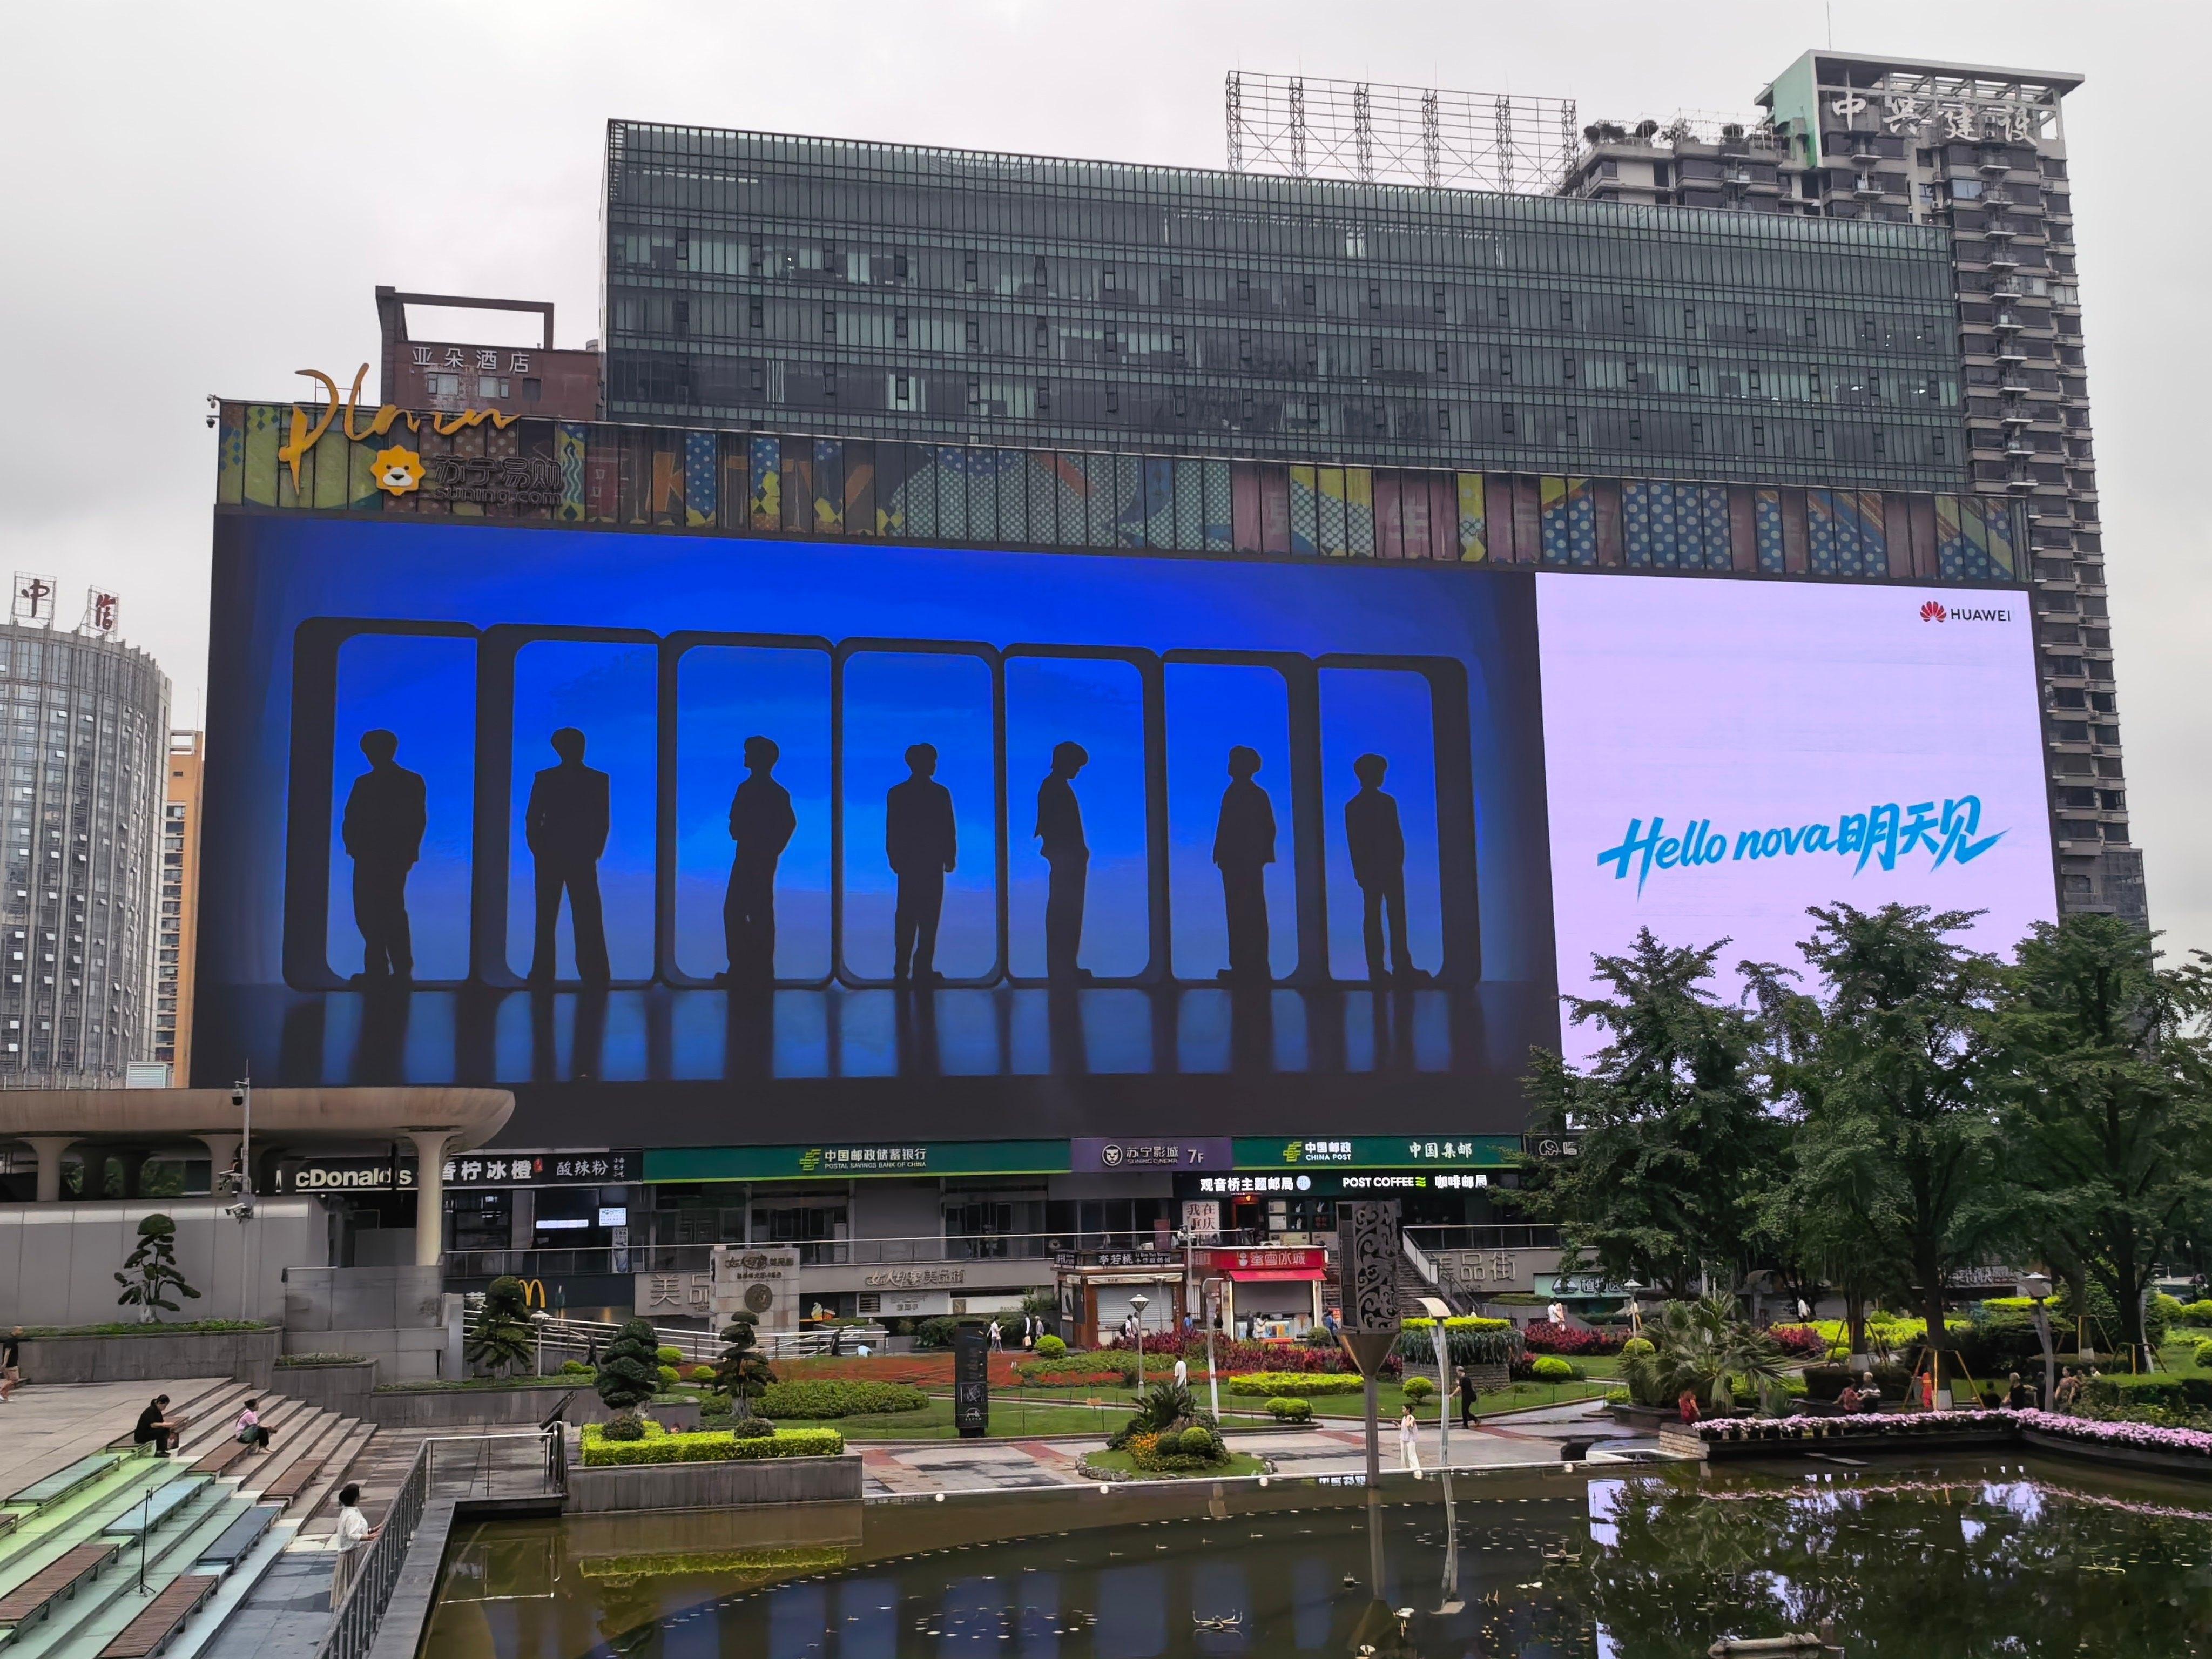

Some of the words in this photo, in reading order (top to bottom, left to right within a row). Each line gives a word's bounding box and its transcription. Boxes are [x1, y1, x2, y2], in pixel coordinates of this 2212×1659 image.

[412, 346, 530, 373] 亚朵酒店
[435, 454, 563, 489] 苏宁易购
[434, 487, 562, 505] suning.com
[1951, 608, 2011, 622] HUAWEI
[1597, 817, 1727, 902] Hello
[1127, 1147, 1178, 1157] 苏宁影城
[1305, 1142, 1351, 1154] 中国邮政
[1410, 1142, 1472, 1159] 中国集邮
[825, 1149, 926, 1162] 中国邮政储蓄银行
[1187, 1149, 1204, 1164] 7F
[557, 1160, 608, 1176] 酸辣粉
[1200, 1177, 1293, 1191] 观音桥主题邮局
[1343, 1177, 1372, 1188] POST
[1373, 1177, 1414, 1187] COFFEE
[1435, 1175, 1487, 1188] 咖啡邮局
[1186, 1203, 1215, 1216] 我在
[1250, 1251, 1306, 1266] 蜜雪冰城
